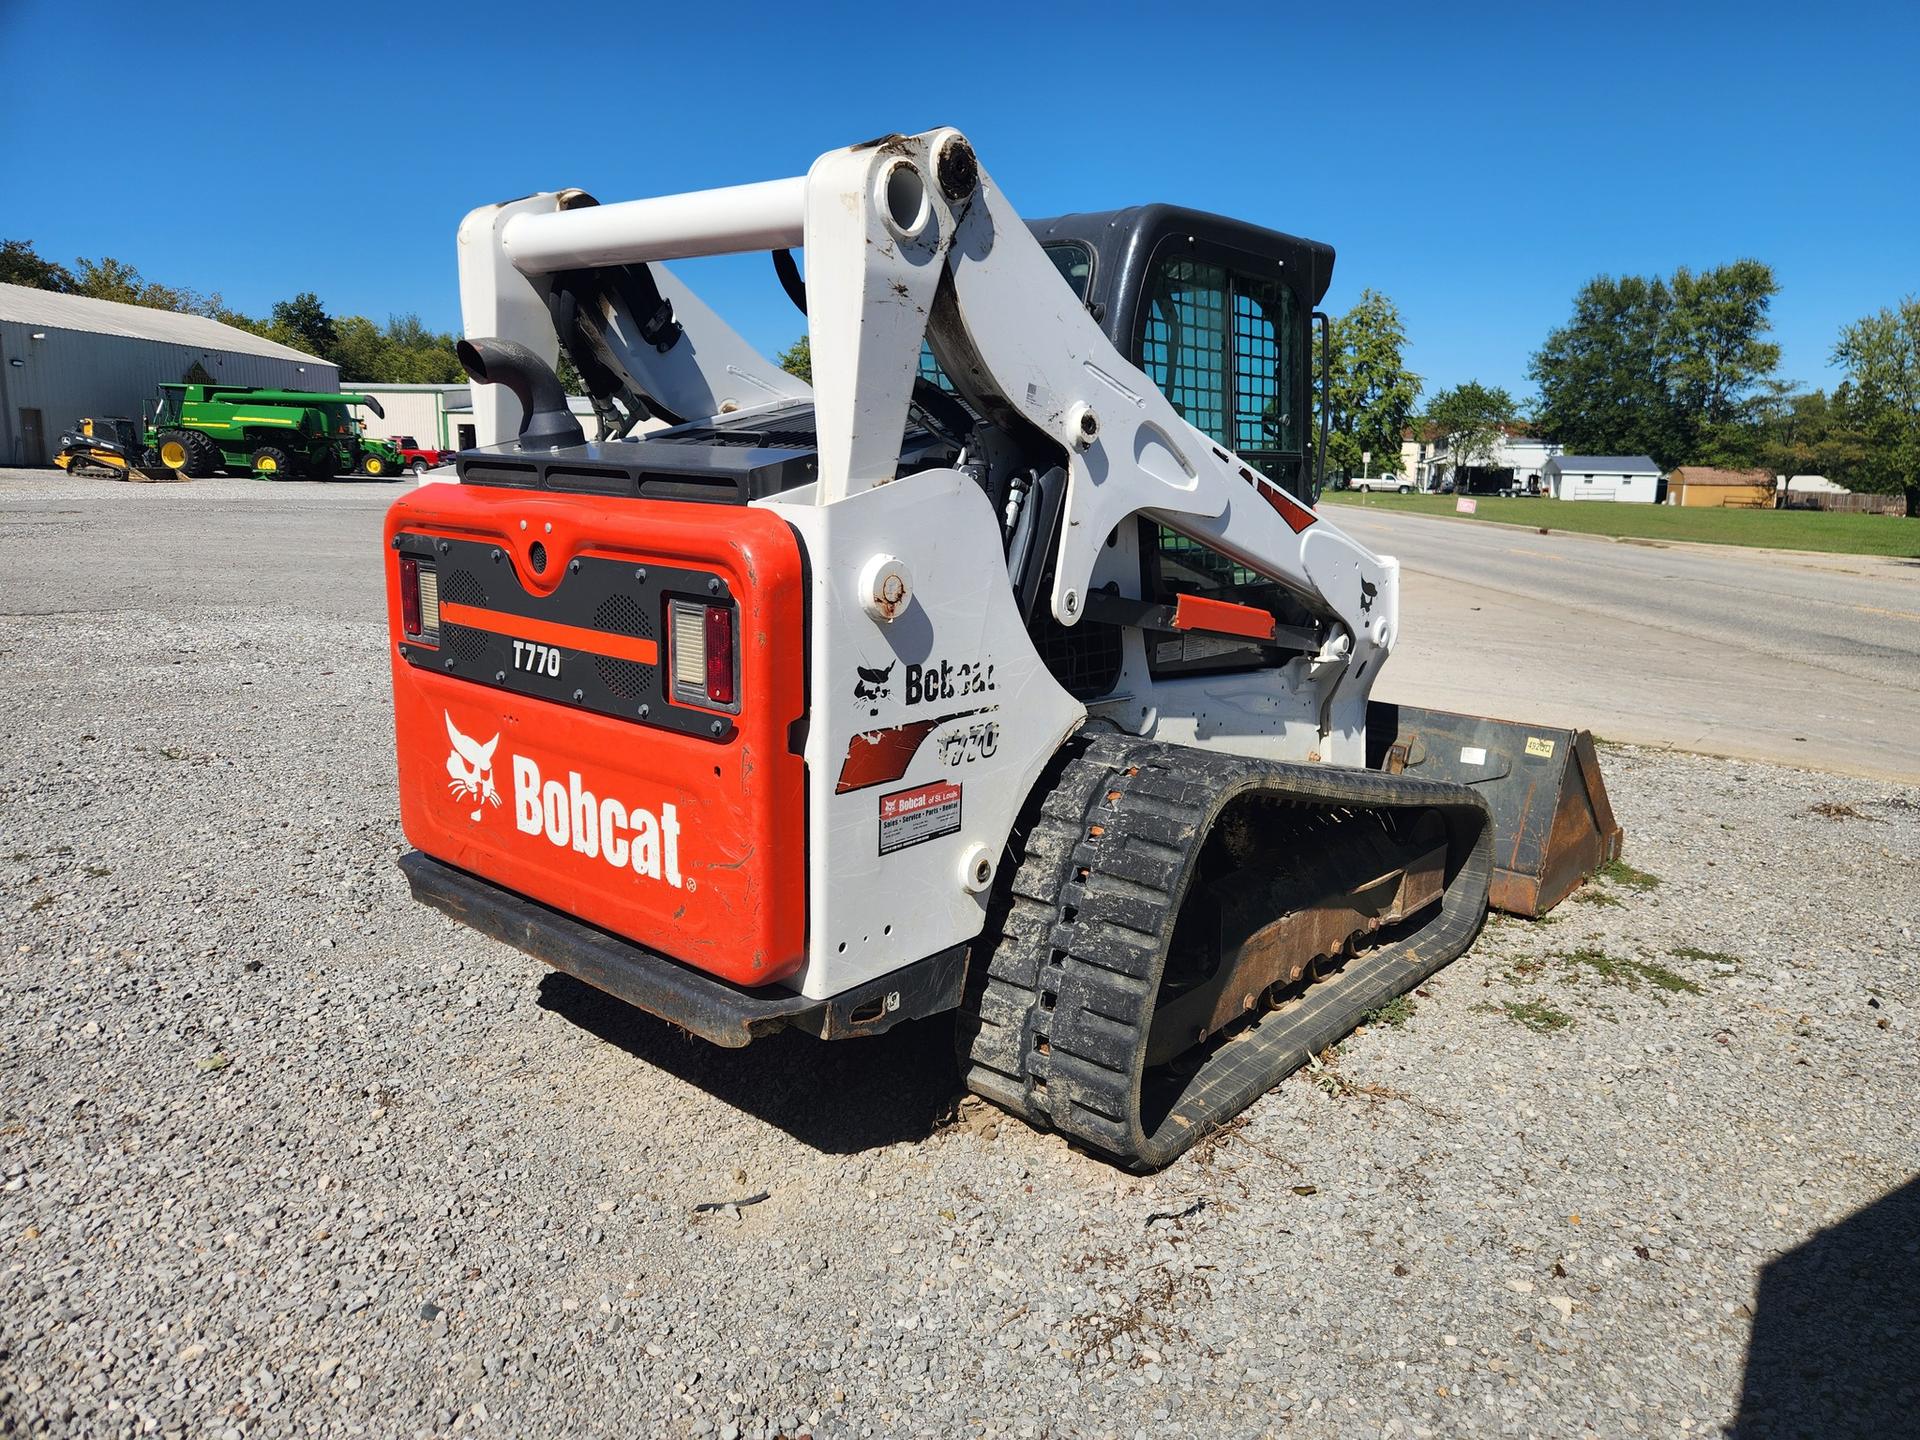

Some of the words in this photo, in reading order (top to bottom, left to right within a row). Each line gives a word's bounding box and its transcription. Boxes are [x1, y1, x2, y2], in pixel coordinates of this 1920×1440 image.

[513, 640, 560, 677] T770
[883, 819, 899, 829] Sales
[902, 813, 921, 823] Service
[925, 808, 939, 816] Parts
[942, 802, 958, 811] Rental
[899, 794, 926, 812] Bobcat
[943, 790, 958, 800] Louis
[512, 754, 682, 889] Bobcat
